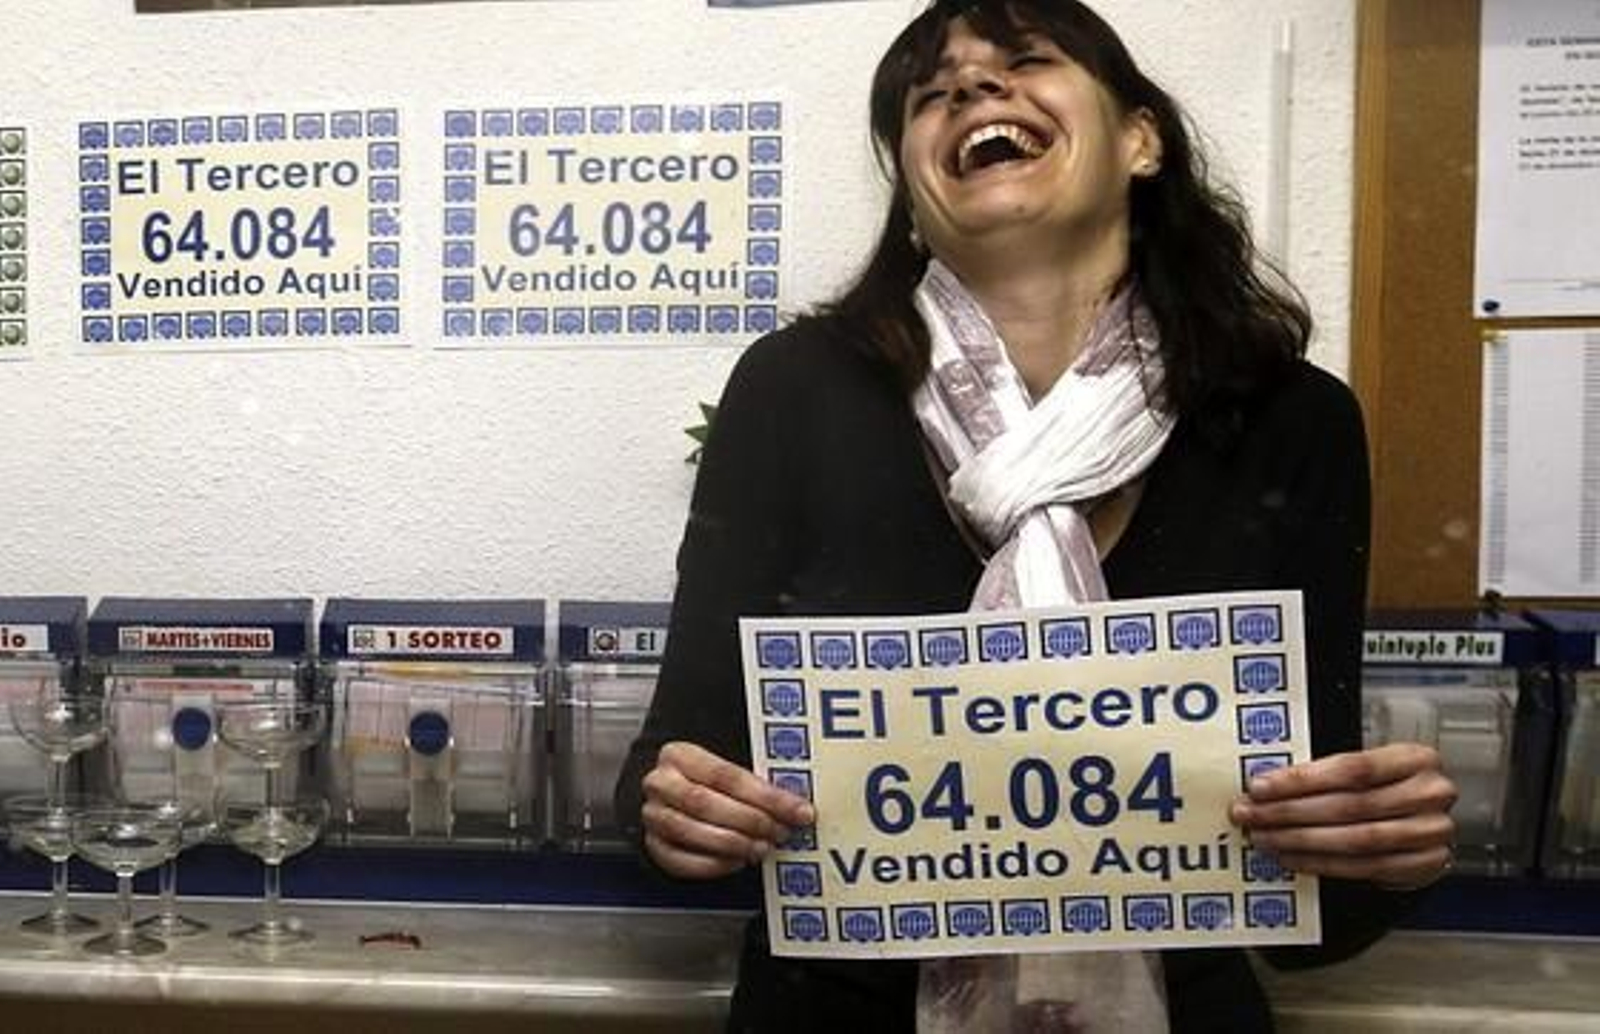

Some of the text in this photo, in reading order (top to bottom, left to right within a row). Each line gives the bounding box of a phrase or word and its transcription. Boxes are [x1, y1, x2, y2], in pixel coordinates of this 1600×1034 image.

[117, 158, 359, 195] El Tercero
[484, 149, 740, 186] El Tercero
[142, 205, 335, 264] 64.084
[508, 200, 712, 257] 64.084
[117, 265, 362, 300] Vendido Aquí
[481, 261, 739, 296] Vendido Aquí
[146, 632, 271, 648] MARTES+VIERNES
[387, 631, 502, 649] 1 SORTEO
[1366, 633, 1495, 660] uintuple Plus
[819, 682, 1219, 739] El Tercero
[864, 752, 1184, 835] 64.084
[829, 832, 1230, 885] Vendido Aquí
